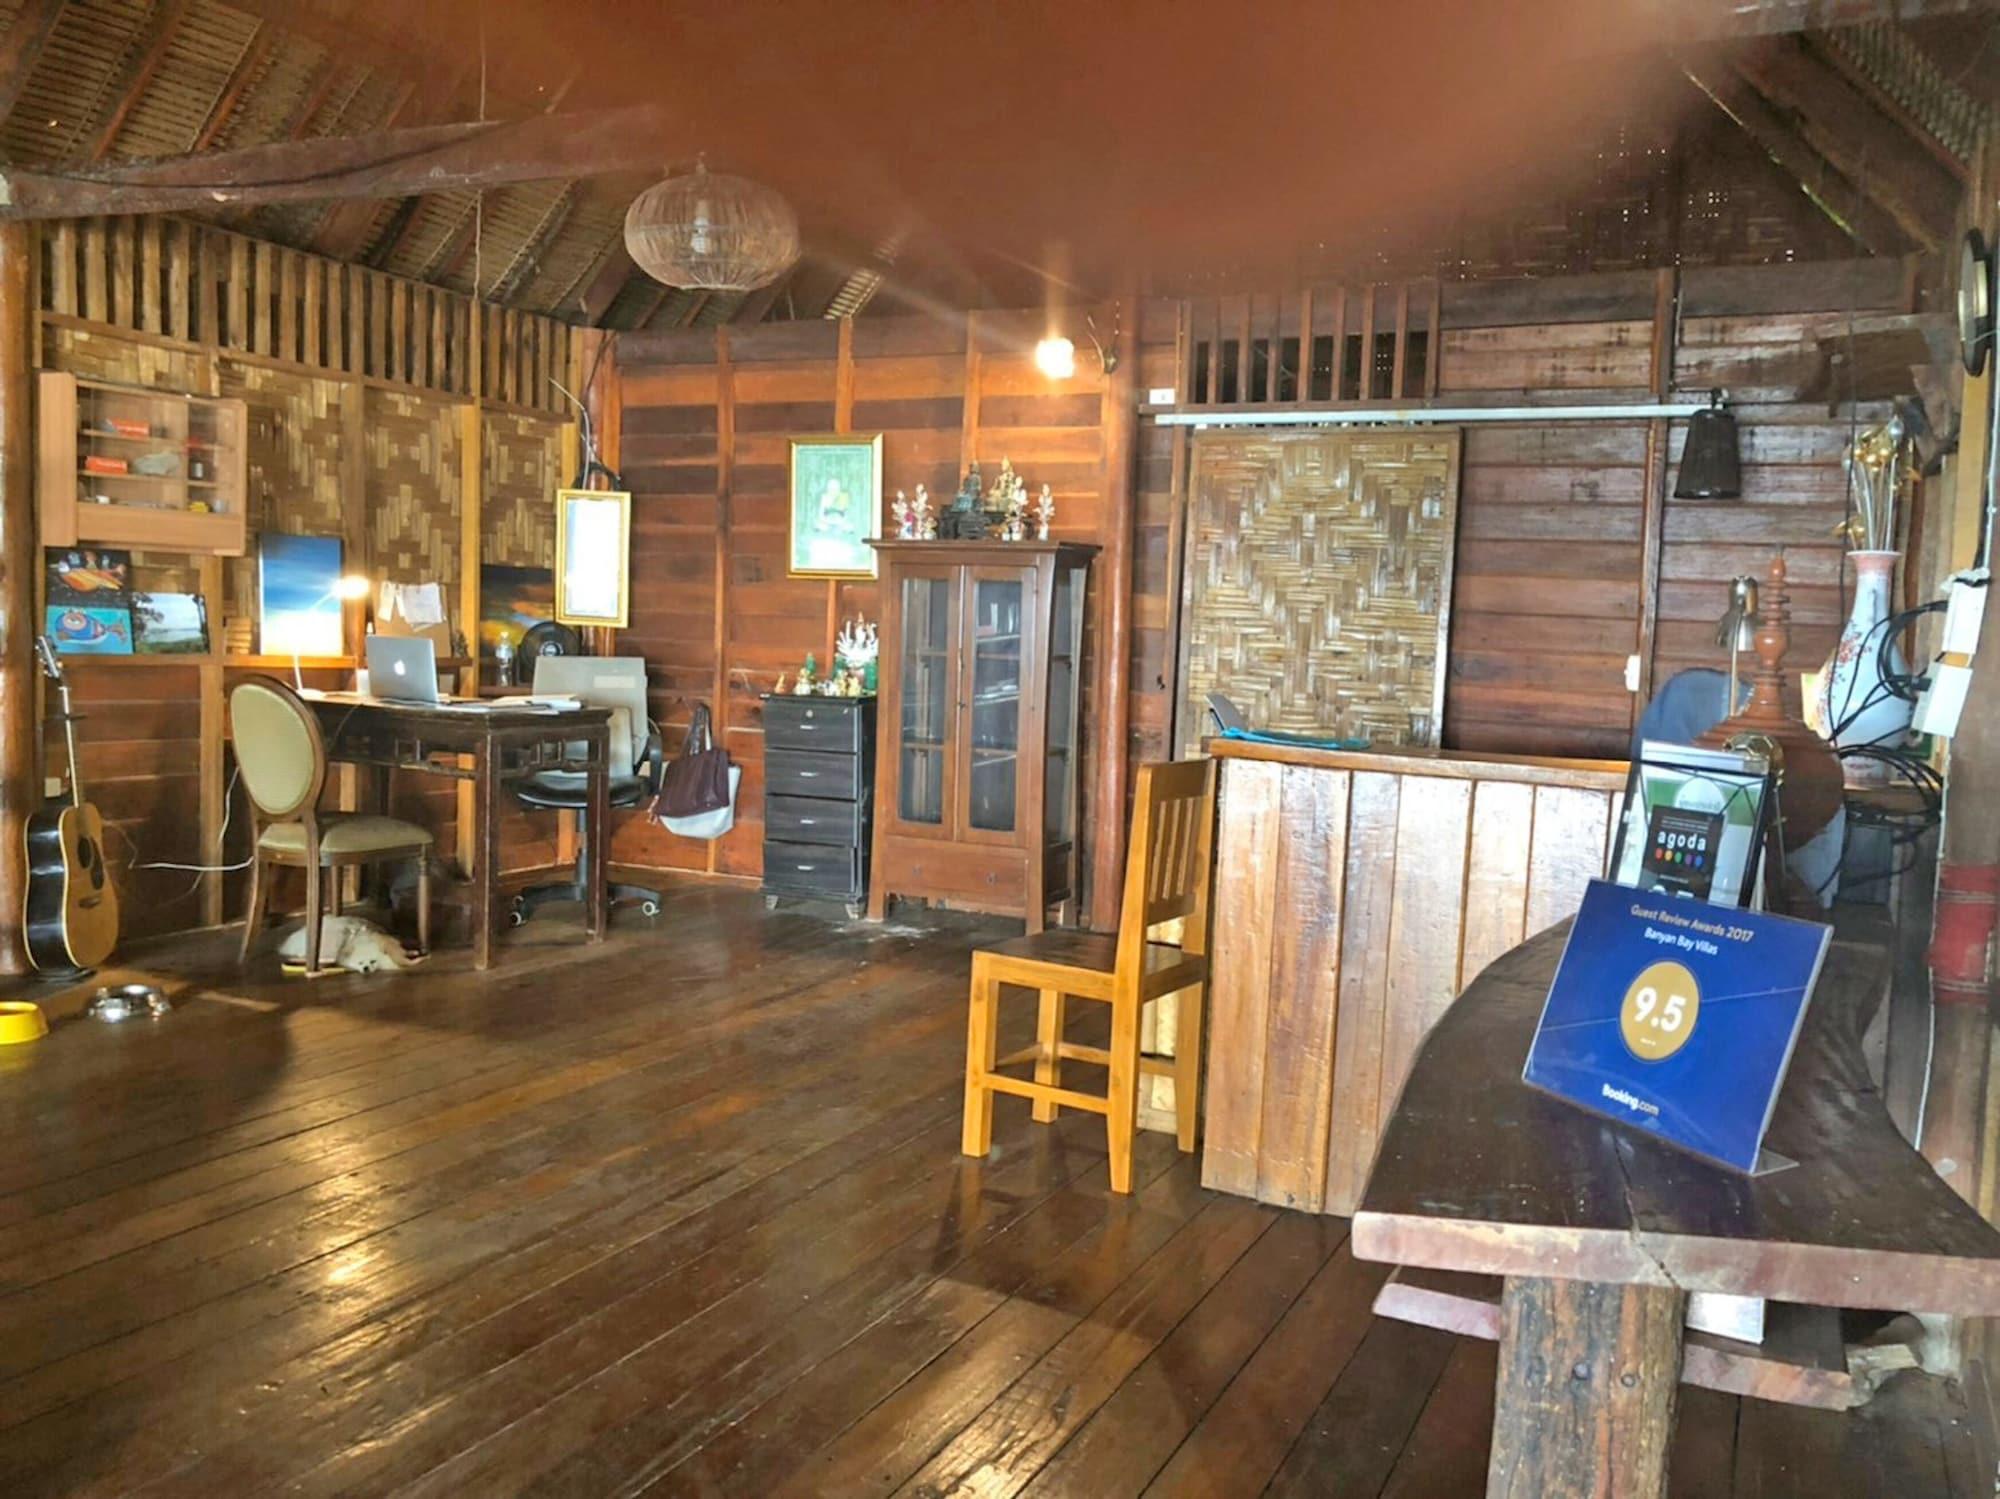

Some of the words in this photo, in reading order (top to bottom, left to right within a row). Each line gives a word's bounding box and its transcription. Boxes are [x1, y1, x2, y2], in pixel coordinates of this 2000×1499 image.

[1657, 831, 1706, 851] agoda
[1631, 904, 1658, 920] Guest
[1658, 910, 1691, 927] Review
[1690, 919, 1725, 936] Awards
[1726, 926, 1754, 942] 2017
[1644, 927, 1677, 944] Banyan
[1677, 935, 1696, 952] Bay
[1695, 940, 1718, 956] Villas
[1634, 986, 1687, 1032] 9.5
[1602, 1083, 1659, 1116] Booking.com
